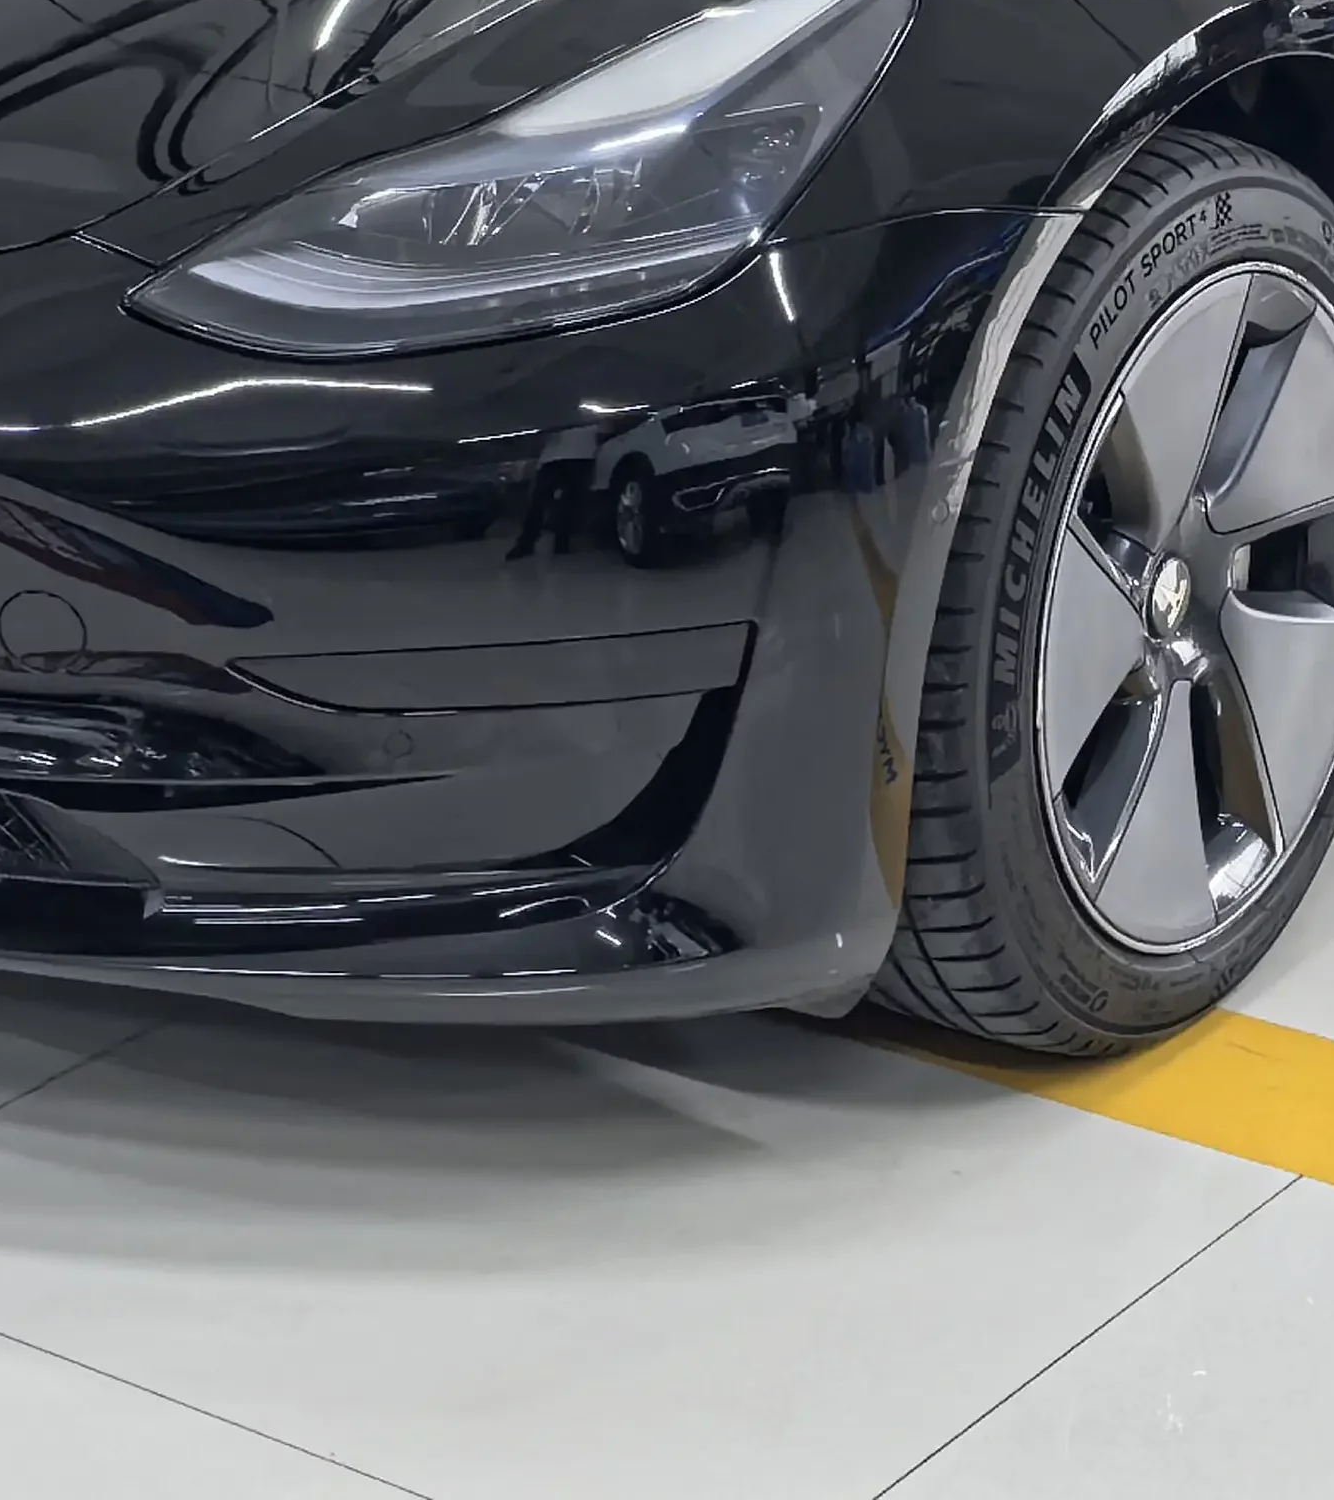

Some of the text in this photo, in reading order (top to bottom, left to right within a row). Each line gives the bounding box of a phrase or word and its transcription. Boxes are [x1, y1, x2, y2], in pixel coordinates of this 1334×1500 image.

[1088, 271, 1136, 350] PILOT
[1140, 212, 1198, 278] SPORT
[993, 372, 1084, 687] MICHELIN
